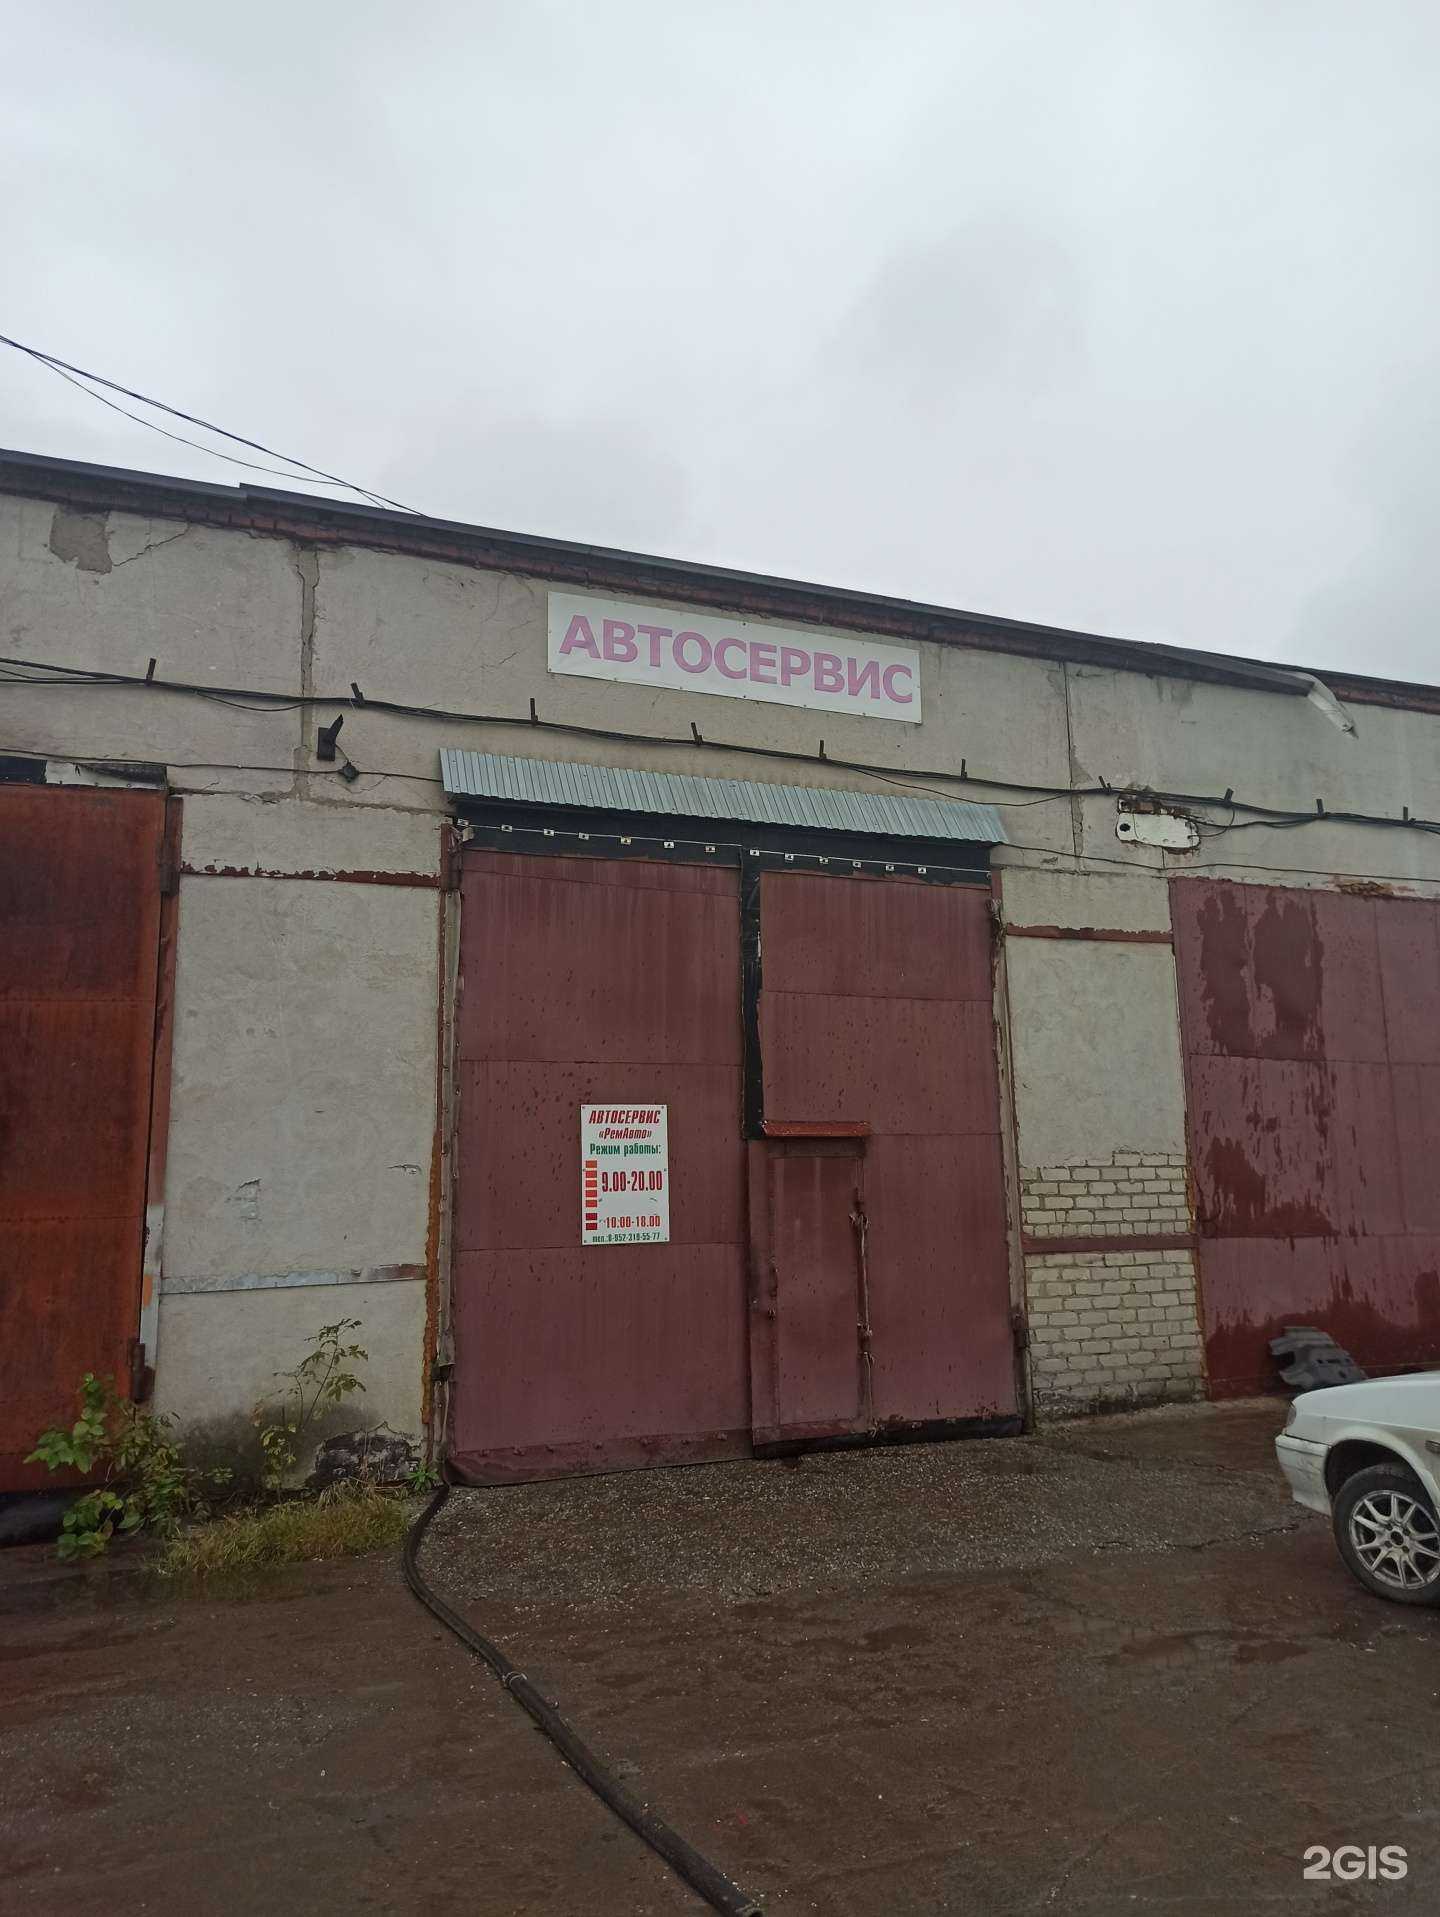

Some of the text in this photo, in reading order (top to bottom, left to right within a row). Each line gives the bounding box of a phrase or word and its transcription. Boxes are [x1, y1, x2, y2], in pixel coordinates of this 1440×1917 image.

[558, 614, 914, 704] АВТОСЕРВИС
[589, 1110, 661, 1124] АВТОСЕРВИС
[590, 1143, 661, 1157] Режим работы:
[602, 1171, 662, 1192] 9.00-20.00
